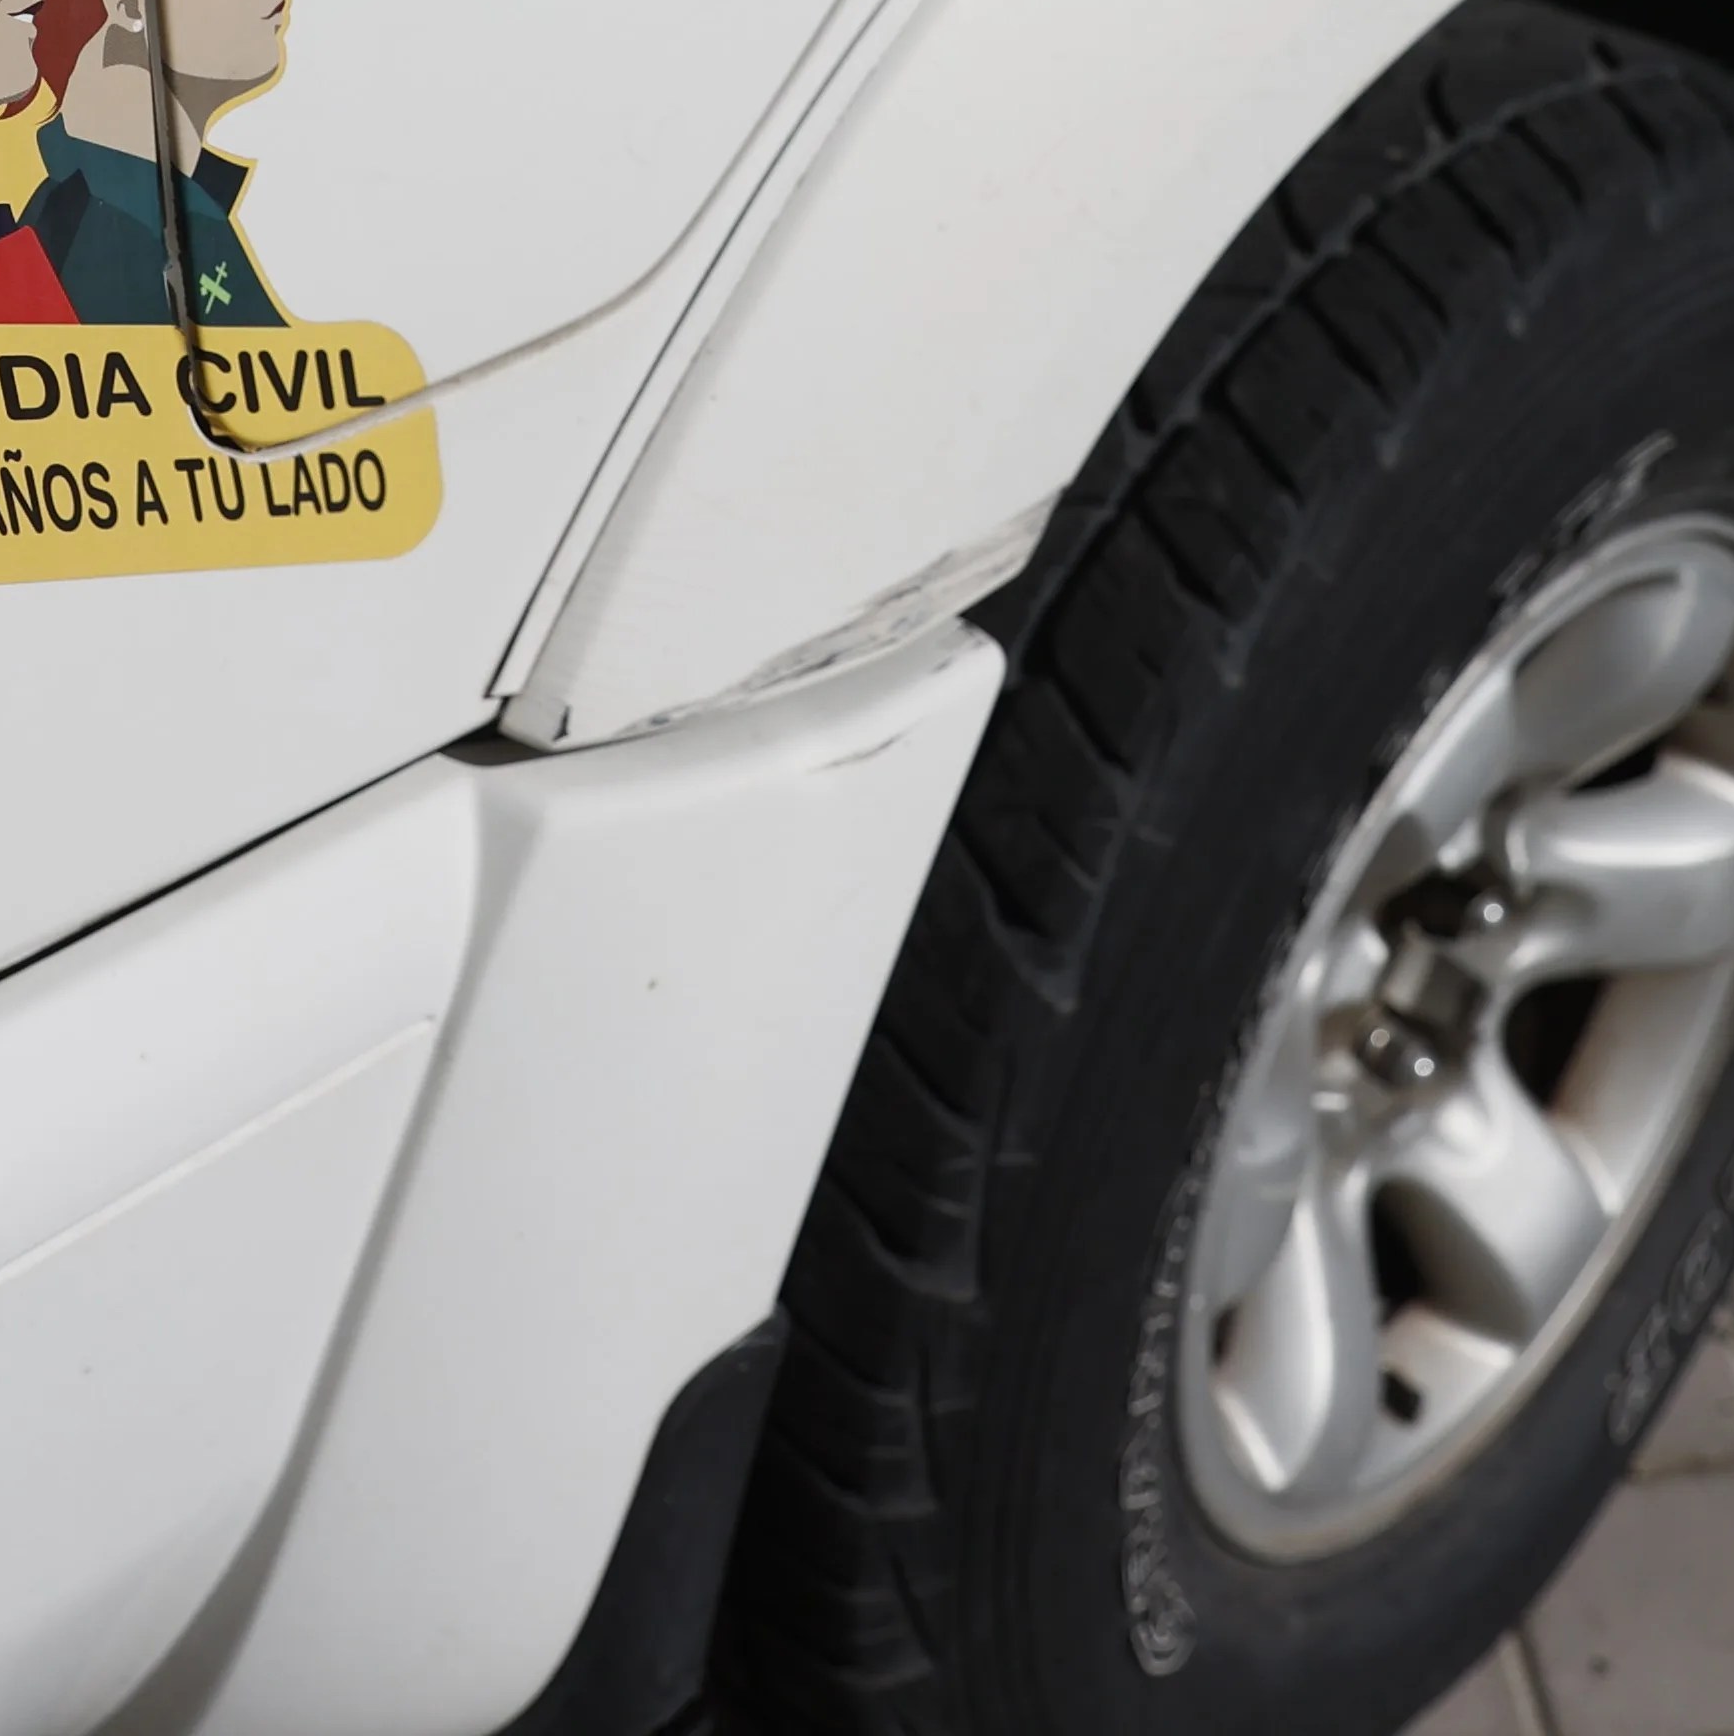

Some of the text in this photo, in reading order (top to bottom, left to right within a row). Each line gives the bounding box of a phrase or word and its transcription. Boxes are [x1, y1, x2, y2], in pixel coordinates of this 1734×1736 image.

[175, 348, 385, 412] CIVIL
[135, 462, 172, 527] A
[184, 459, 245, 522] TU
[266, 451, 388, 517] LADO
